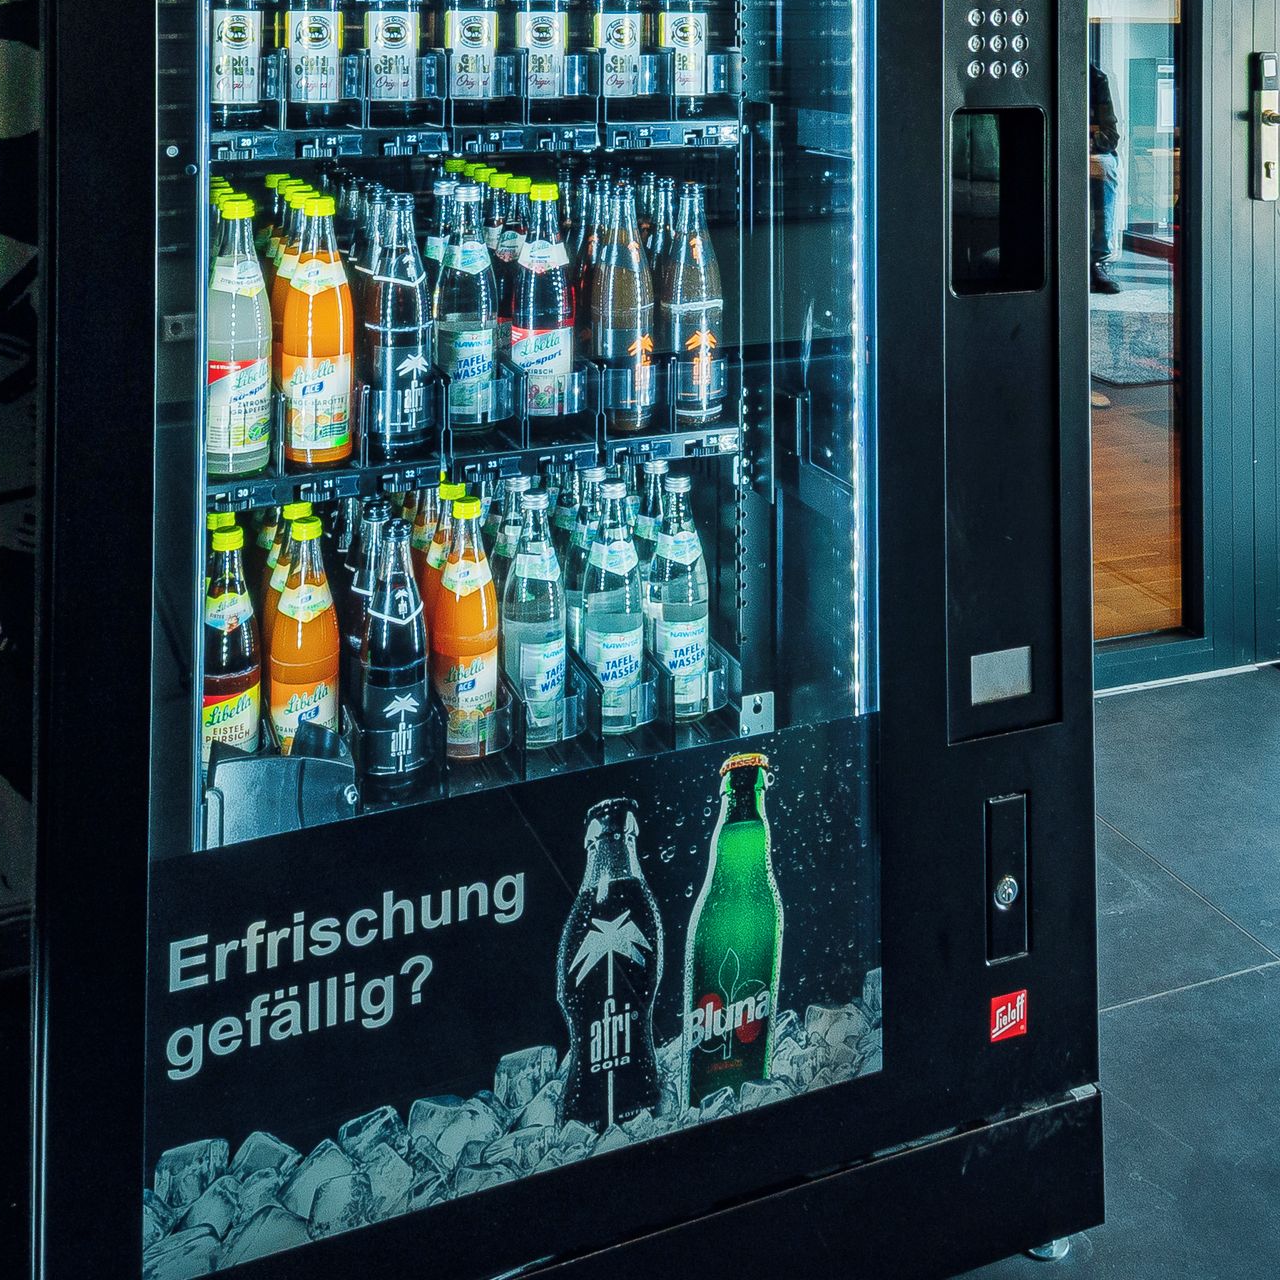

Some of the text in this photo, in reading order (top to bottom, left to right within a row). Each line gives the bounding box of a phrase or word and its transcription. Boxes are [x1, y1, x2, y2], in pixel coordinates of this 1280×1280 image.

[407, 134, 418, 143] 22
[489, 133, 500, 141] 23
[564, 131, 573, 139] 24
[639, 129, 649, 137] 25
[240, 138, 252, 147] 20
[326, 137, 336, 146] 21
[453, 361, 493, 381] WASSER
[305, 383, 322, 396] ACE
[404, 380, 424, 409] afri
[640, 444, 650, 452] 35
[487, 460, 498, 468] 33
[563, 453, 573, 461] 34
[404, 470, 415, 478] 32
[323, 479, 334, 488] 31
[237, 488, 249, 498] 30
[669, 648, 705, 670] WASSER
[445, 656, 485, 685] Libella
[600, 660, 640, 682] WASSER
[457, 679, 474, 692] ACE
[284, 681, 329, 715] Libella
[205, 694, 253, 727] Libella
[301, 706, 318, 720] ACE
[205, 730, 251, 744] PFIRSICH
[212, 725, 246, 736] EISTEE
[391, 721, 413, 752] afri
[168, 870, 527, 994] Erfrischung
[166, 954, 435, 1082] gefällig?
[680, 989, 772, 1052] Bluna
[991, 991, 1027, 1036] Sielaff
[590, 997, 632, 1065] afri
[589, 1055, 632, 1074] cola
